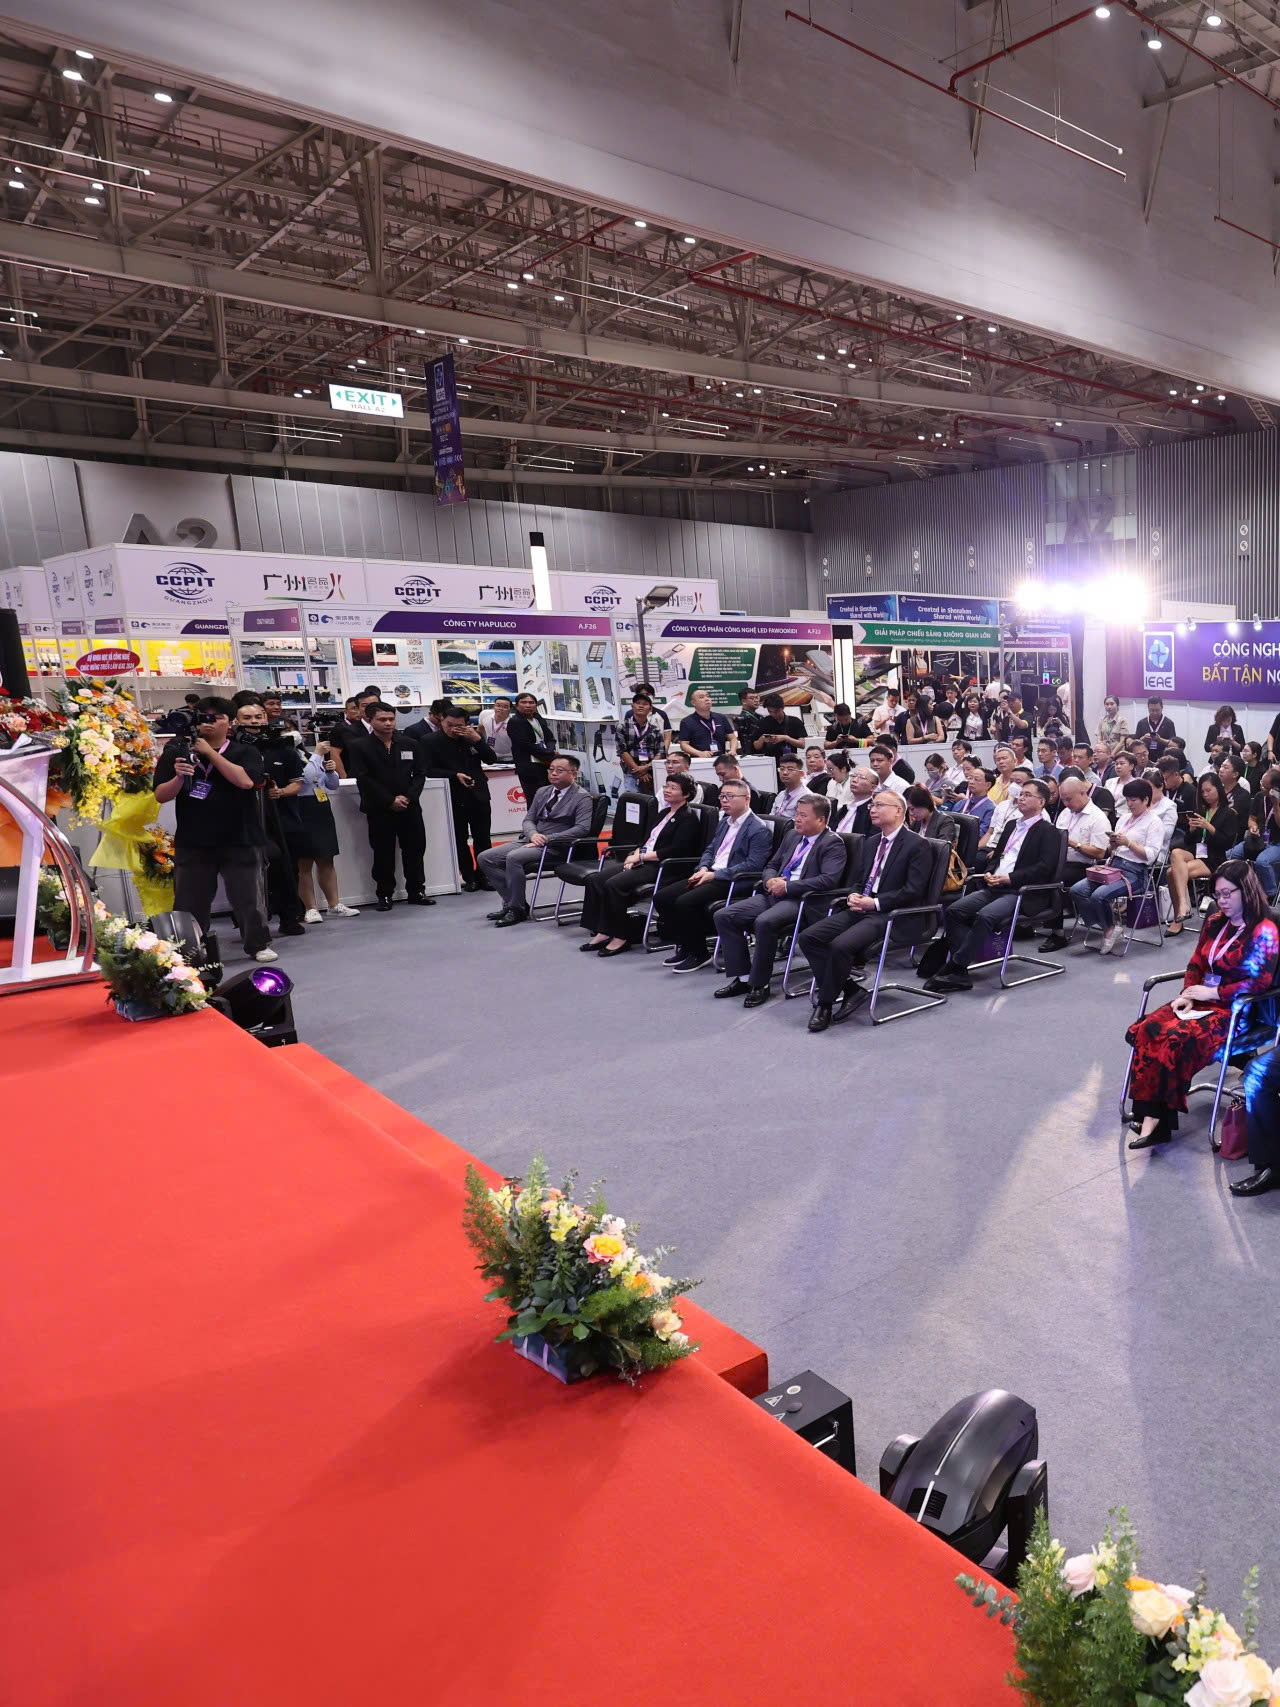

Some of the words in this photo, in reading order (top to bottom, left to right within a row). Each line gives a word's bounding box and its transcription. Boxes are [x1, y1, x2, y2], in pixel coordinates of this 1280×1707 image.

[345, 390, 387, 406] EXIT
[156, 575, 215, 588] CCPIT
[395, 586, 442, 598] CCPIT
[164, 595, 213, 606] GUANGZHOU
[584, 595, 622, 605] CCPIT
[947, 607, 972, 615] Shenzhen
[953, 613, 965, 621] with
[966, 614, 981, 622] World
[194, 623, 230, 631] GUANGZH
[443, 619, 466, 628] CÔNG
[467, 620, 477, 628] TY
[478, 621, 517, 629] HAPULICO
[671, 624, 689, 632] CÔNG
[699, 624, 707, 633] CỔ
[707, 625, 721, 633] PHẦN
[722, 625, 741, 633] CÔNG
[741, 626, 757, 635] NGHỆ
[874, 628, 888, 636] GIẢI
[907, 629, 925, 637] CHIẾU
[925, 629, 942, 637] SÁNG
[943, 630, 964, 638] KHÔNG
[980, 631, 991, 639] LỚN
[1213, 640, 1249, 657] CÔNG
[1202, 662, 1229, 682] BẤT
[1232, 664, 1262, 685] TẬN
[1145, 676, 1173, 688] IEAE
